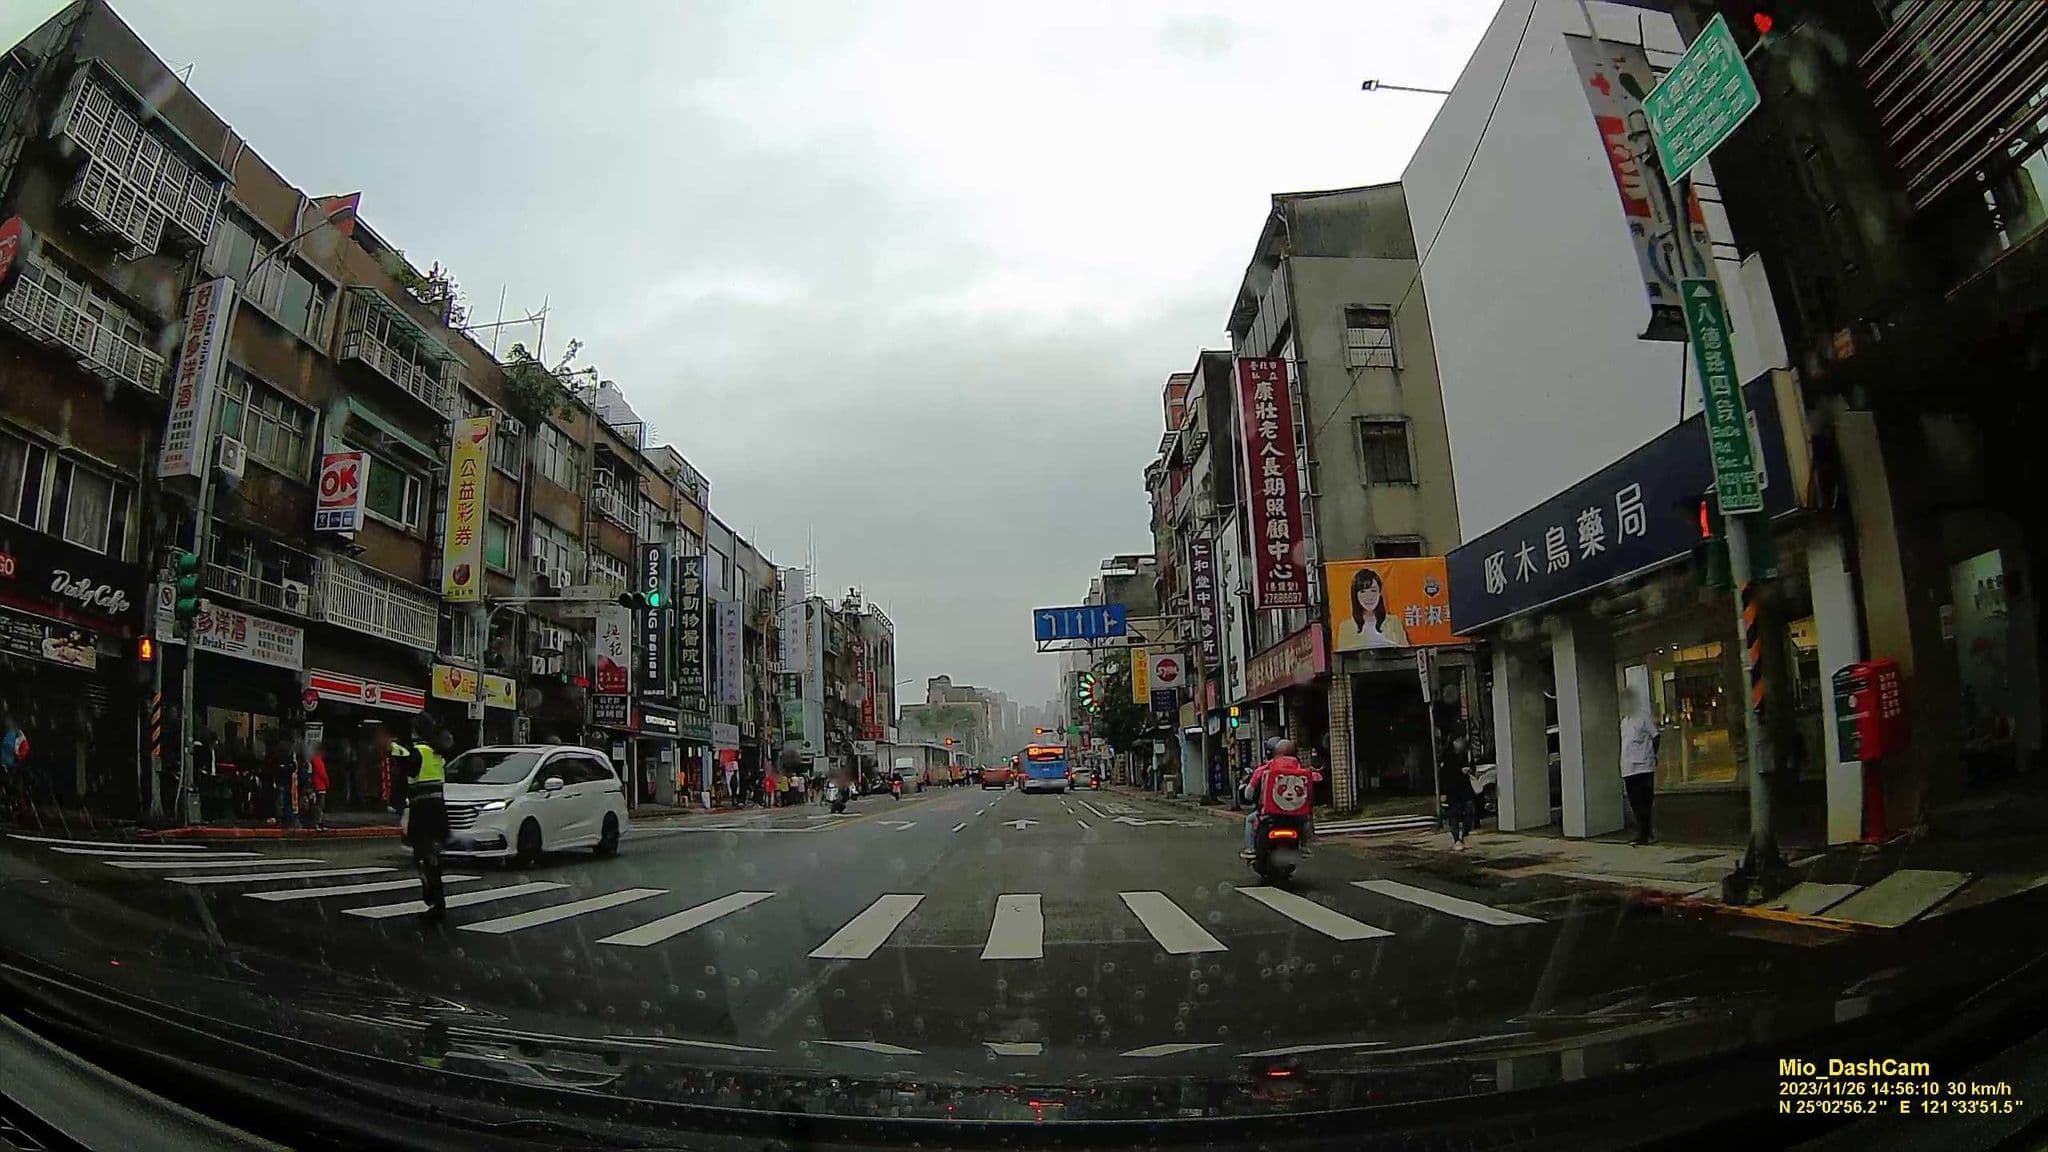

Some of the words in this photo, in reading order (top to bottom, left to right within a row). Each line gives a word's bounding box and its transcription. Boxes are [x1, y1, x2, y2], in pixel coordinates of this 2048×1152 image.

[1697, 302, 1737, 426] 八德路四段
[321, 464, 358, 497] OK
[455, 458, 477, 546] 公益彩券
[1253, 381, 1293, 580] 康壯老人長期照顧中心
[50, 569, 94, 607] Daily
[1483, 482, 1648, 596] 啄木鳥藥局
